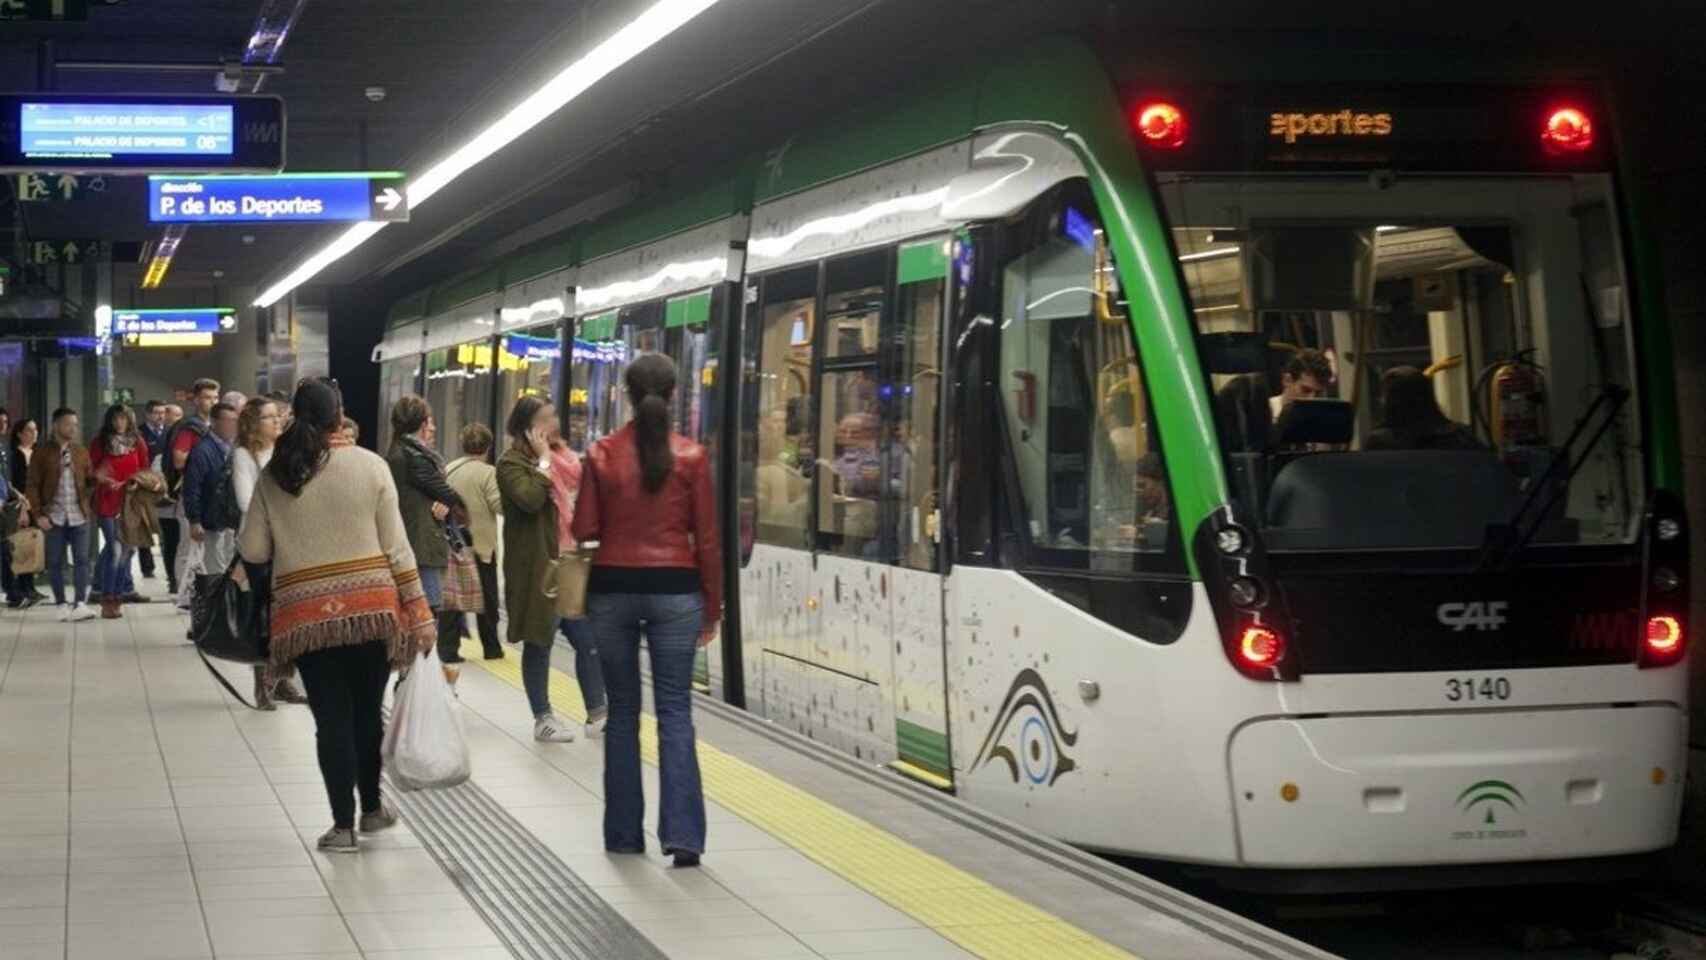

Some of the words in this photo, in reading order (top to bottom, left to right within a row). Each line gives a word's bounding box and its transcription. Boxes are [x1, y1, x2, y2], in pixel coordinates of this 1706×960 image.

[73, 115, 117, 127] PALACIO
[73, 136, 117, 147] PALACIO
[160, 197, 176, 214] P.
[180, 197, 205, 214] de
[209, 197, 237, 214] los
[241, 196, 323, 217] Deportes
[1437, 601, 1508, 631] CAF
[1446, 677, 1511, 701] 3140
